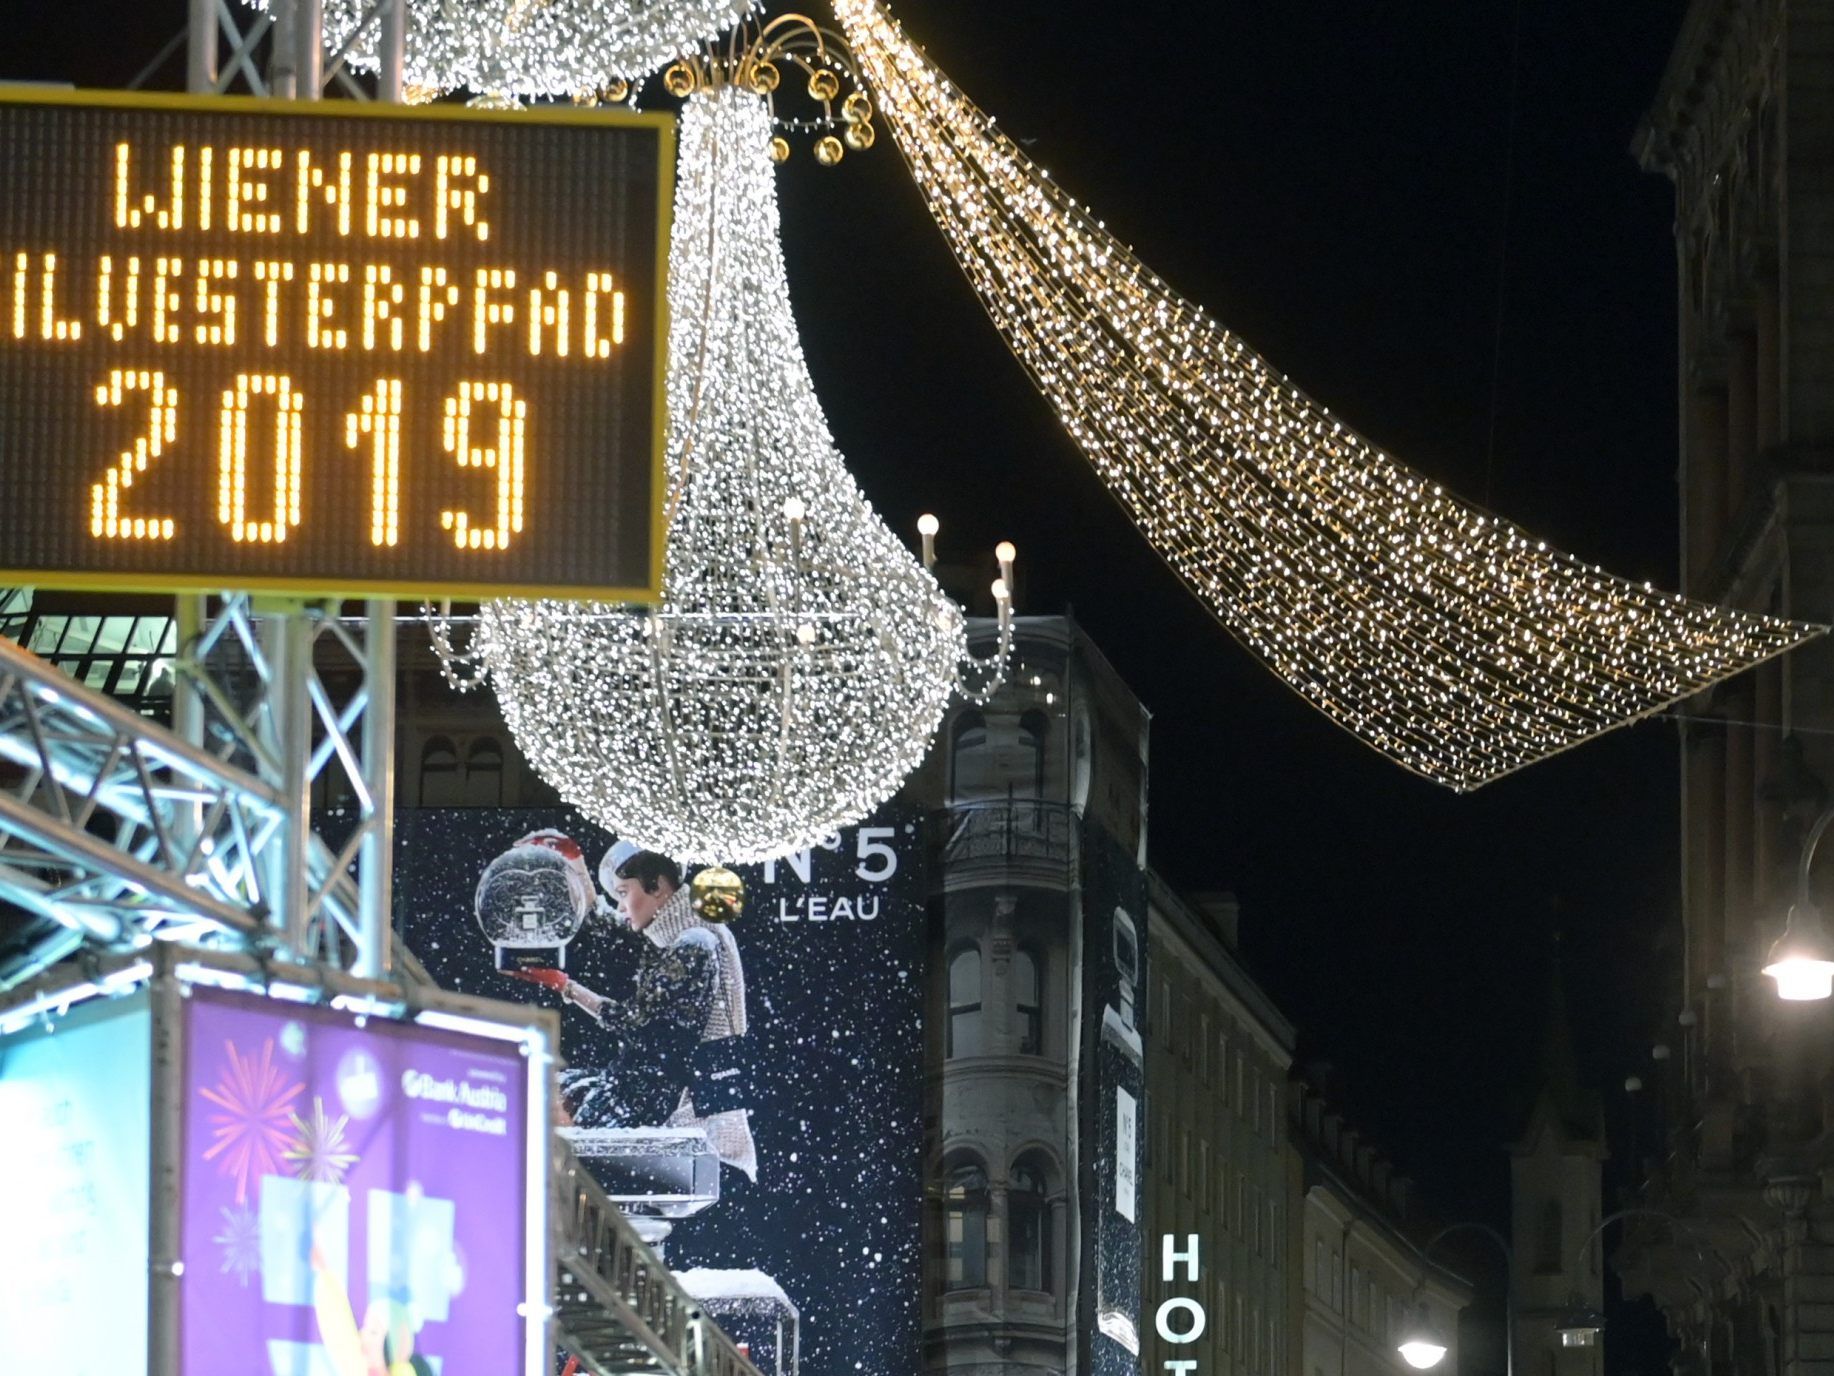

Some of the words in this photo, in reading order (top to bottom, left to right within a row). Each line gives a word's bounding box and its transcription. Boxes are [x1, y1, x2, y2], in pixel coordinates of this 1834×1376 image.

[115, 143, 489, 240] WIENER
[12, 252, 625, 358] ILVESTERPFAD
[90, 368, 527, 550] 2019
[855, 827, 898, 882] 5
[780, 896, 879, 922] L'EAU
